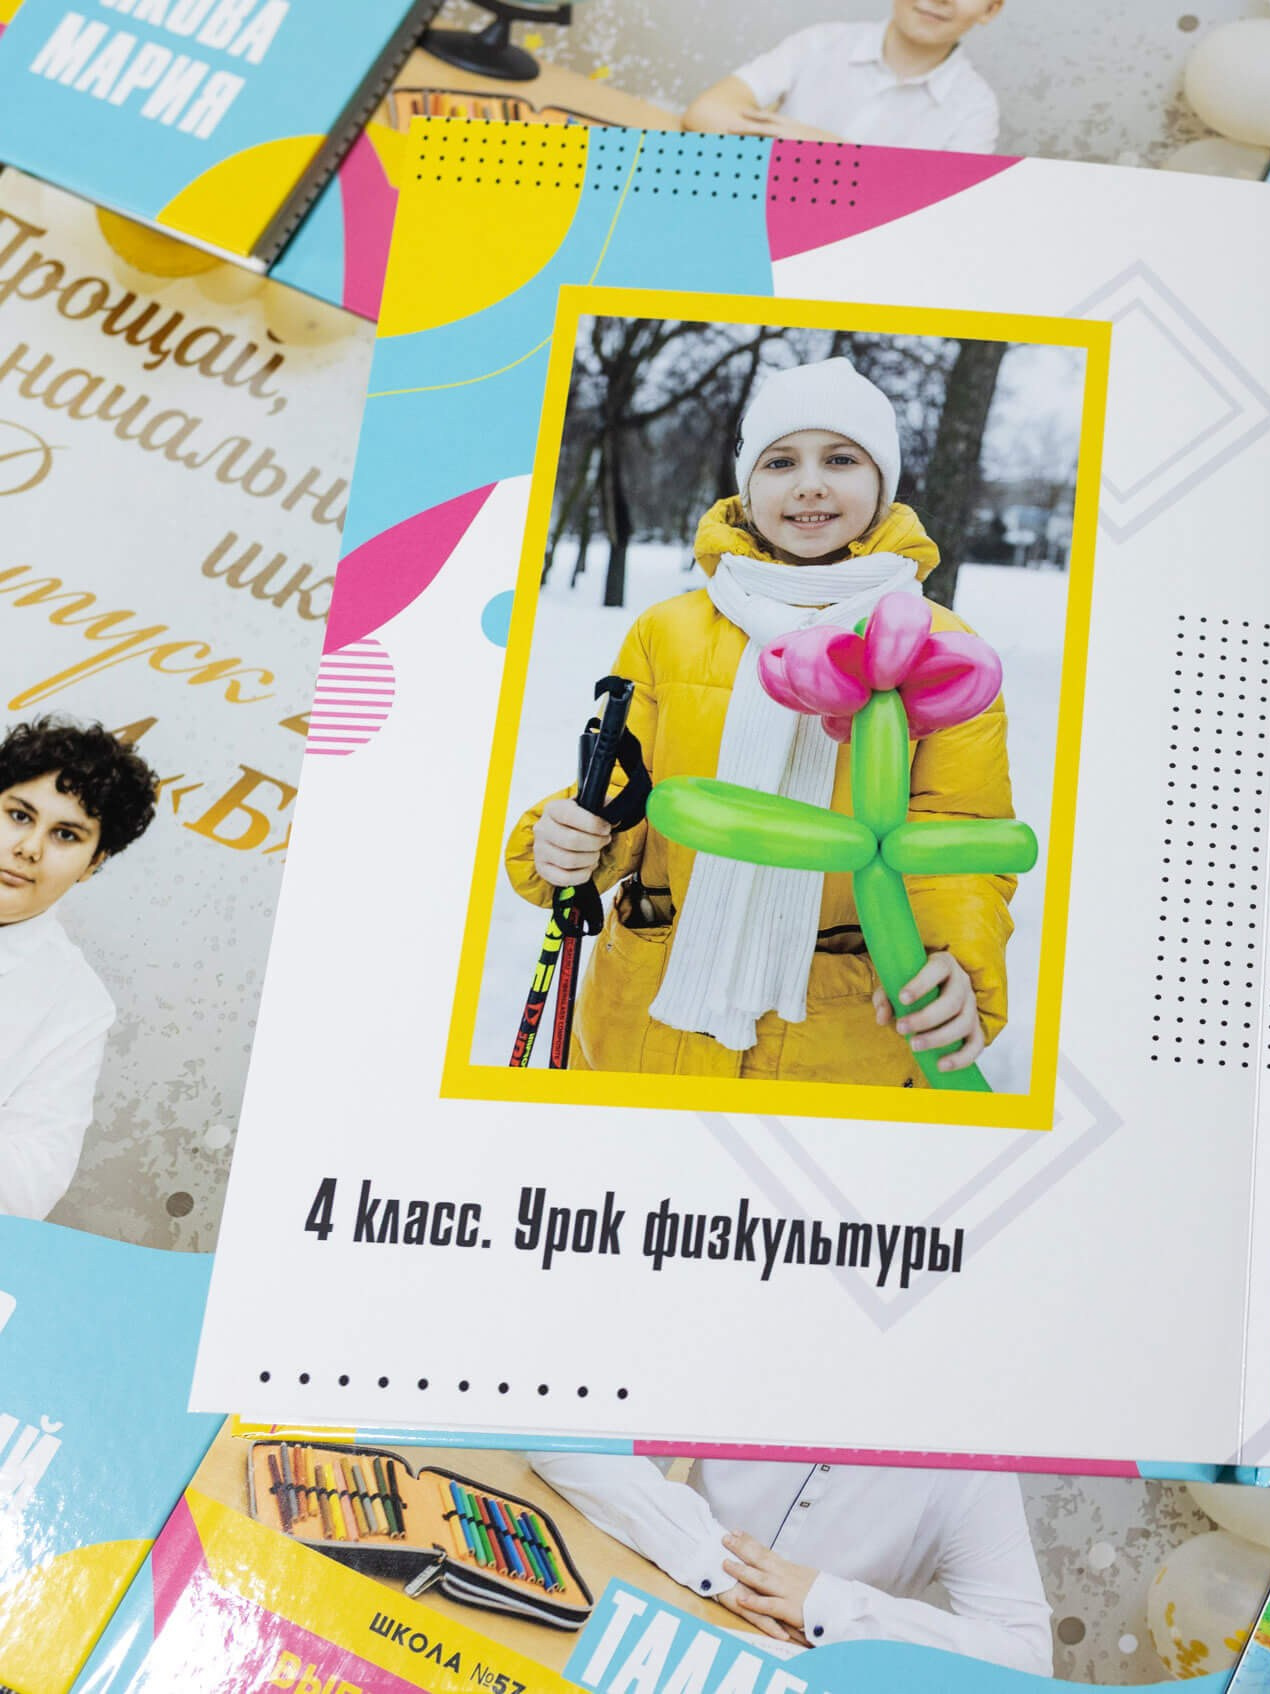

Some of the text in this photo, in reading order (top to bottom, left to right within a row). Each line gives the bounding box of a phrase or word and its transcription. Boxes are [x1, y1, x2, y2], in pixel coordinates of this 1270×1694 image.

[28, 10, 247, 140] МАРИЯ
[0, 343, 349, 535] начальн
[304, 1177, 966, 1290] 4 класс. Урок физкультуры
[369, 1611, 462, 1674] ШКОЛА
